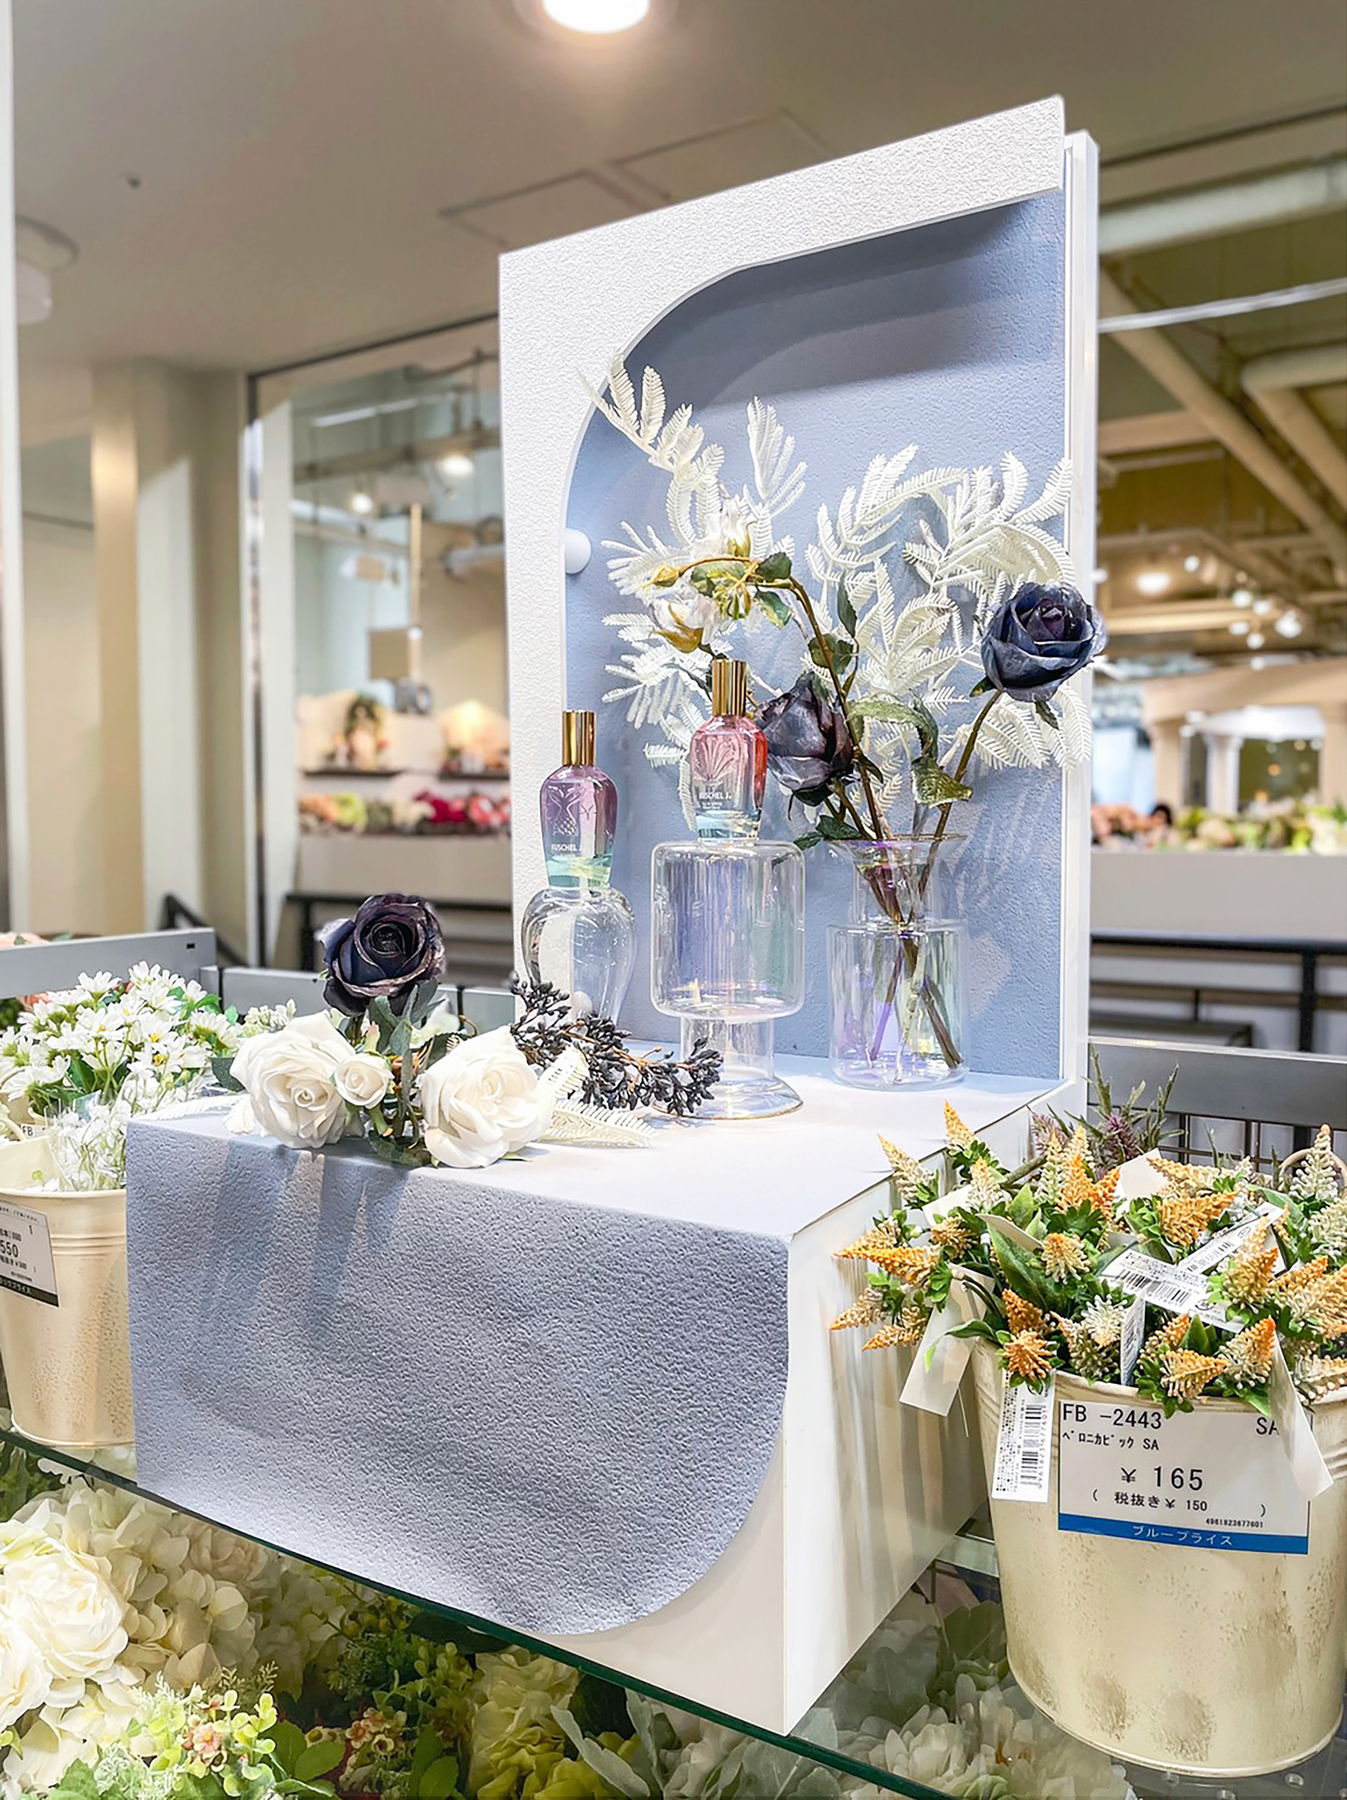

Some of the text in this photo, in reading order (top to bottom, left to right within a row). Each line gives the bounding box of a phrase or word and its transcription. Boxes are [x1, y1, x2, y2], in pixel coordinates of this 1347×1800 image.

[1062, 1404, 1280, 1435] FB -2443 SA
[1142, 1437, 1160, 1451] SA
[1121, 1466, 1203, 1491] ¥ 165
[1186, 1500, 1208, 1512] 150
